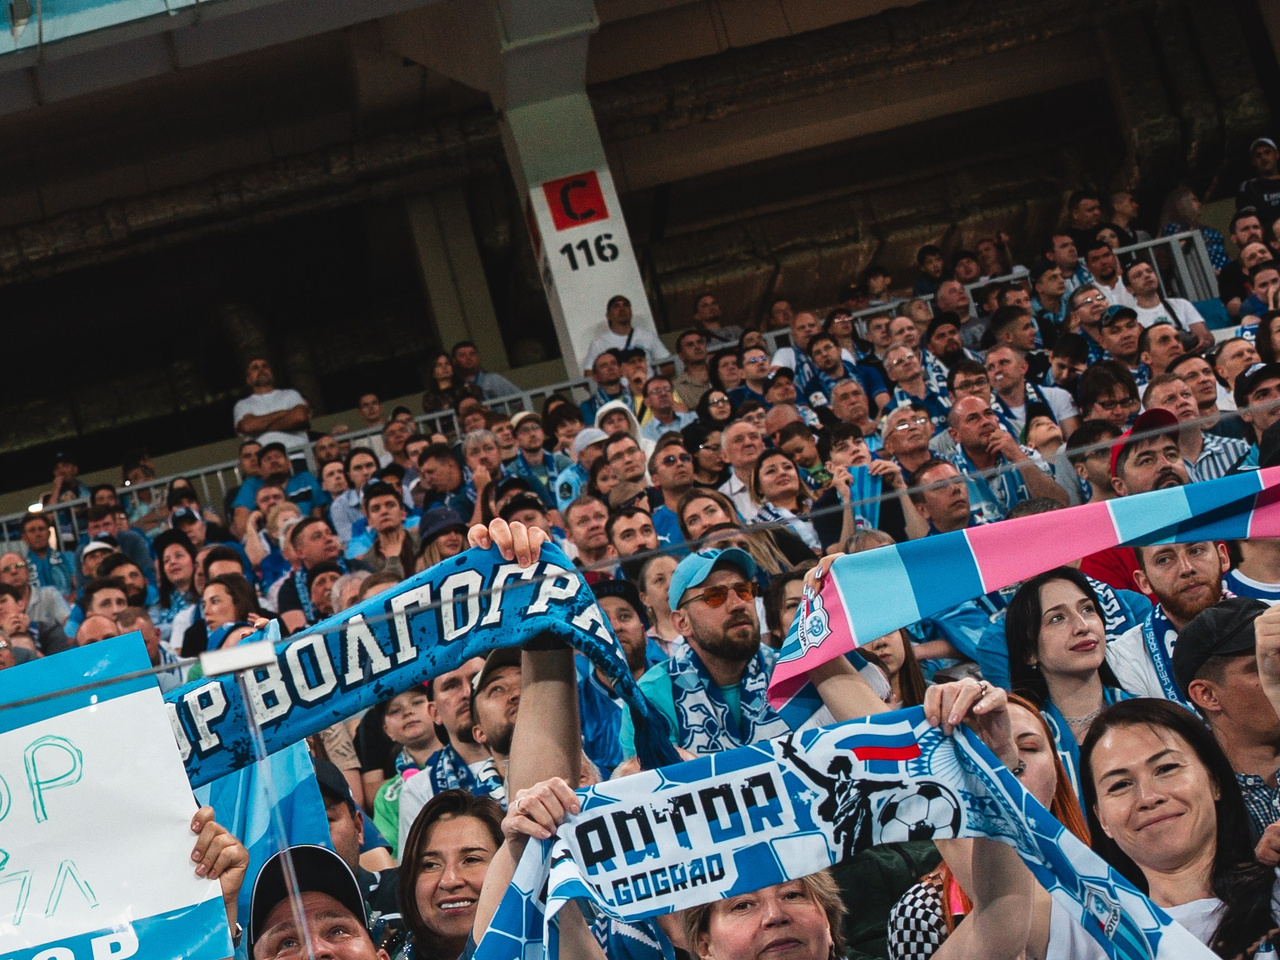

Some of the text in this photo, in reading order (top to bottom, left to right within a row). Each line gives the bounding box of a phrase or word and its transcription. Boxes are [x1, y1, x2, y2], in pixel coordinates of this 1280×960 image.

[559, 233, 619, 271] 116
[244, 561, 628, 727] ВОЛГОГРА
[596, 852, 726, 907] LGOGRAD
